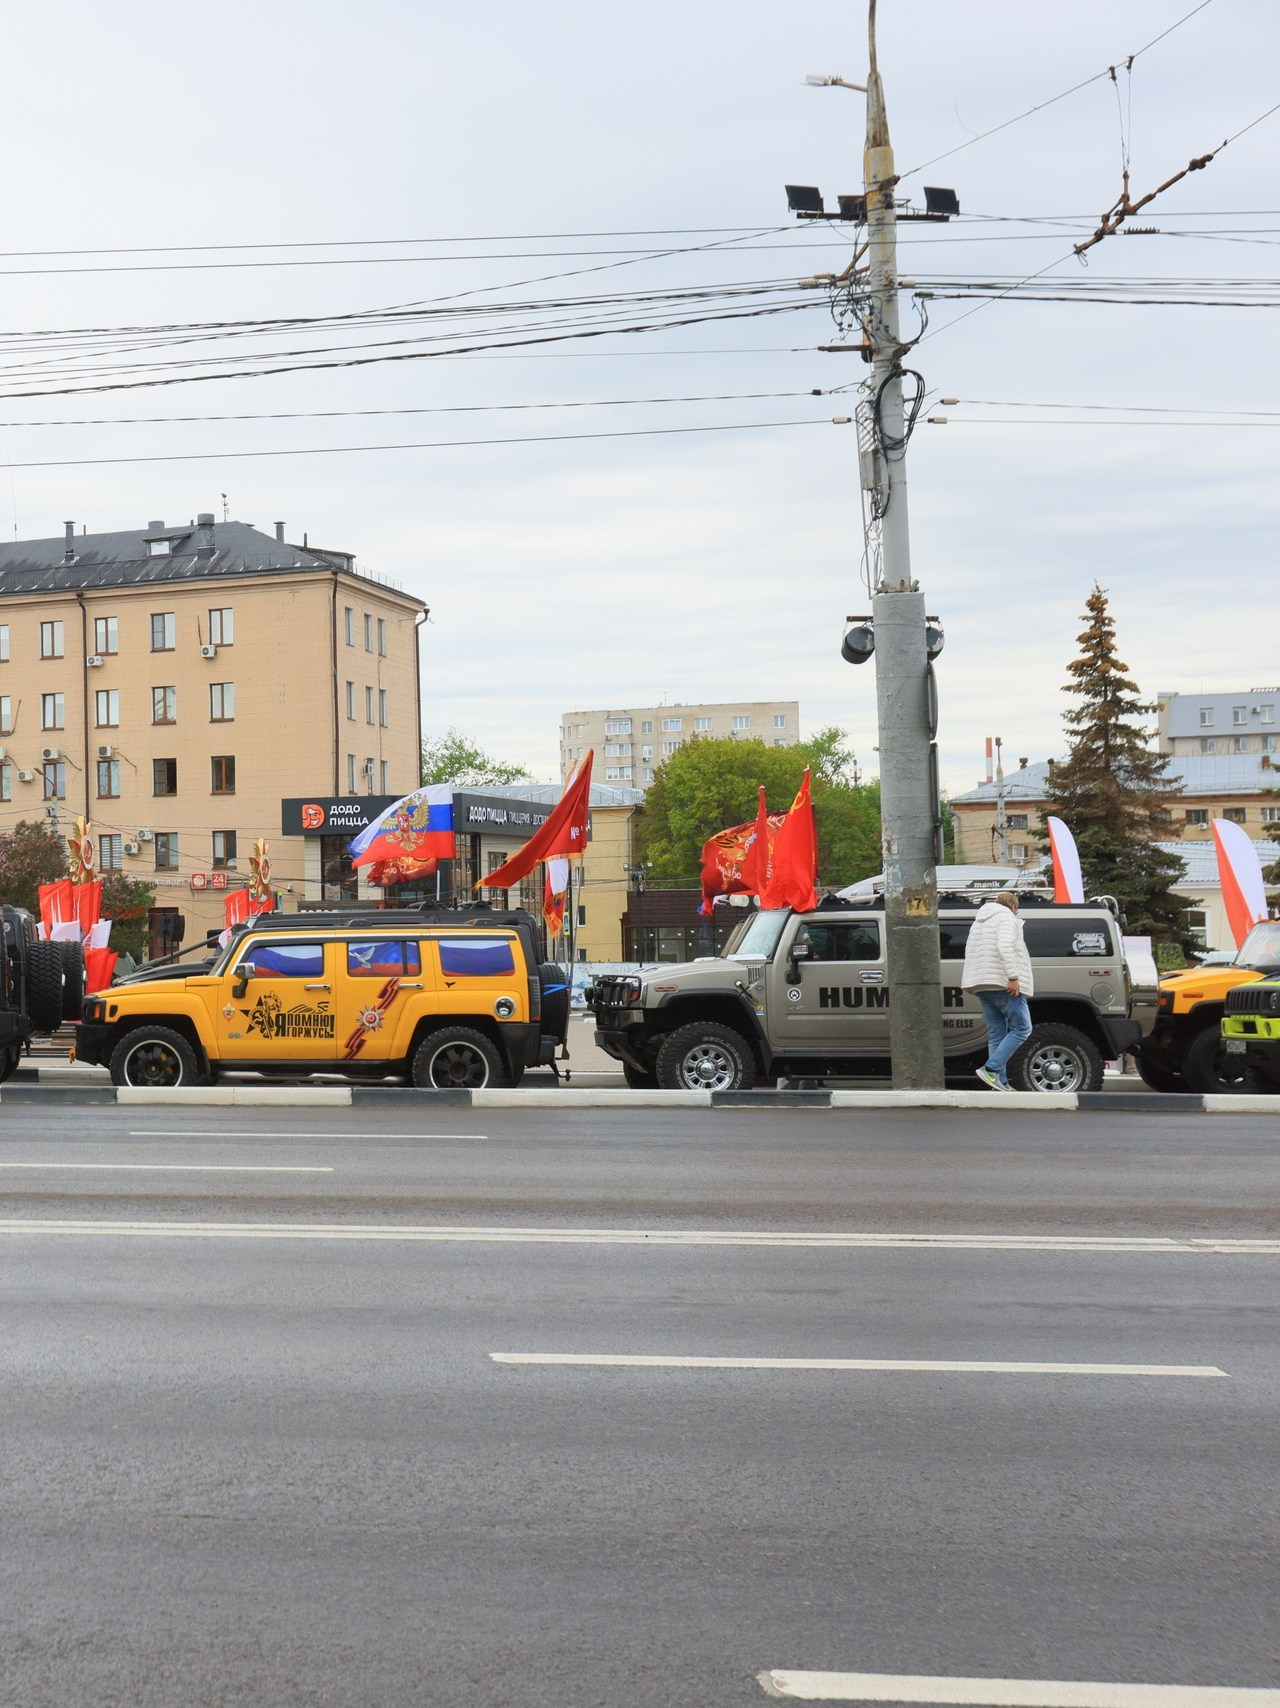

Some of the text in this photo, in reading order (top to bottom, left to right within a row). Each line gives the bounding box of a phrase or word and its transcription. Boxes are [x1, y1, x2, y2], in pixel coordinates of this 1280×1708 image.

[330, 805, 361, 815] ДОДО
[469, 806, 487, 823] ДОДО
[486, 808, 508, 825] ПИЦЦА
[508, 811, 530, 825] ПИЦЦЕРИЯ
[330, 816, 369, 826] ПИЦЦА
[819, 986, 964, 1008] HUMR
[274, 1014, 330, 1036] Я ПОМНЮ
[956, 1020, 974, 1028] ELSE
